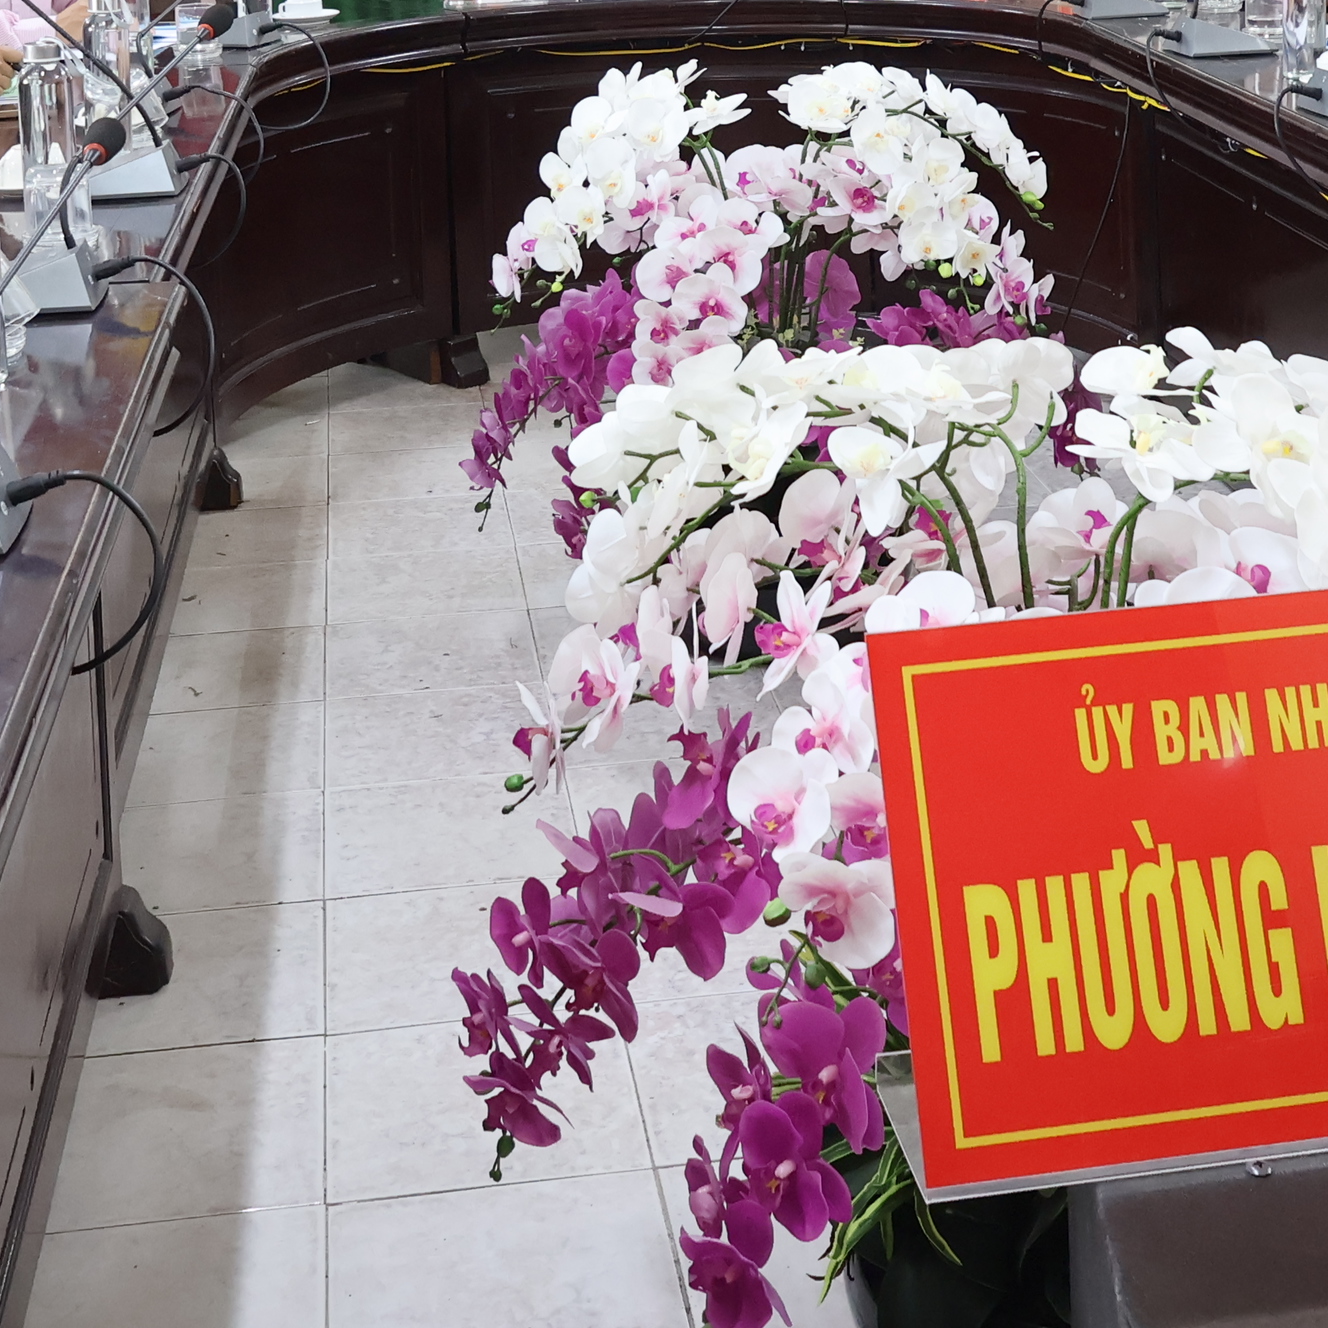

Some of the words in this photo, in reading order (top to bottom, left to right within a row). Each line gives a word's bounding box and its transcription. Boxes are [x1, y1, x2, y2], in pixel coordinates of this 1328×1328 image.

[1074, 683, 1135, 774] ỦY
[1153, 691, 1252, 766] BAN
[962, 819, 1305, 1063] PHƯỜNG
